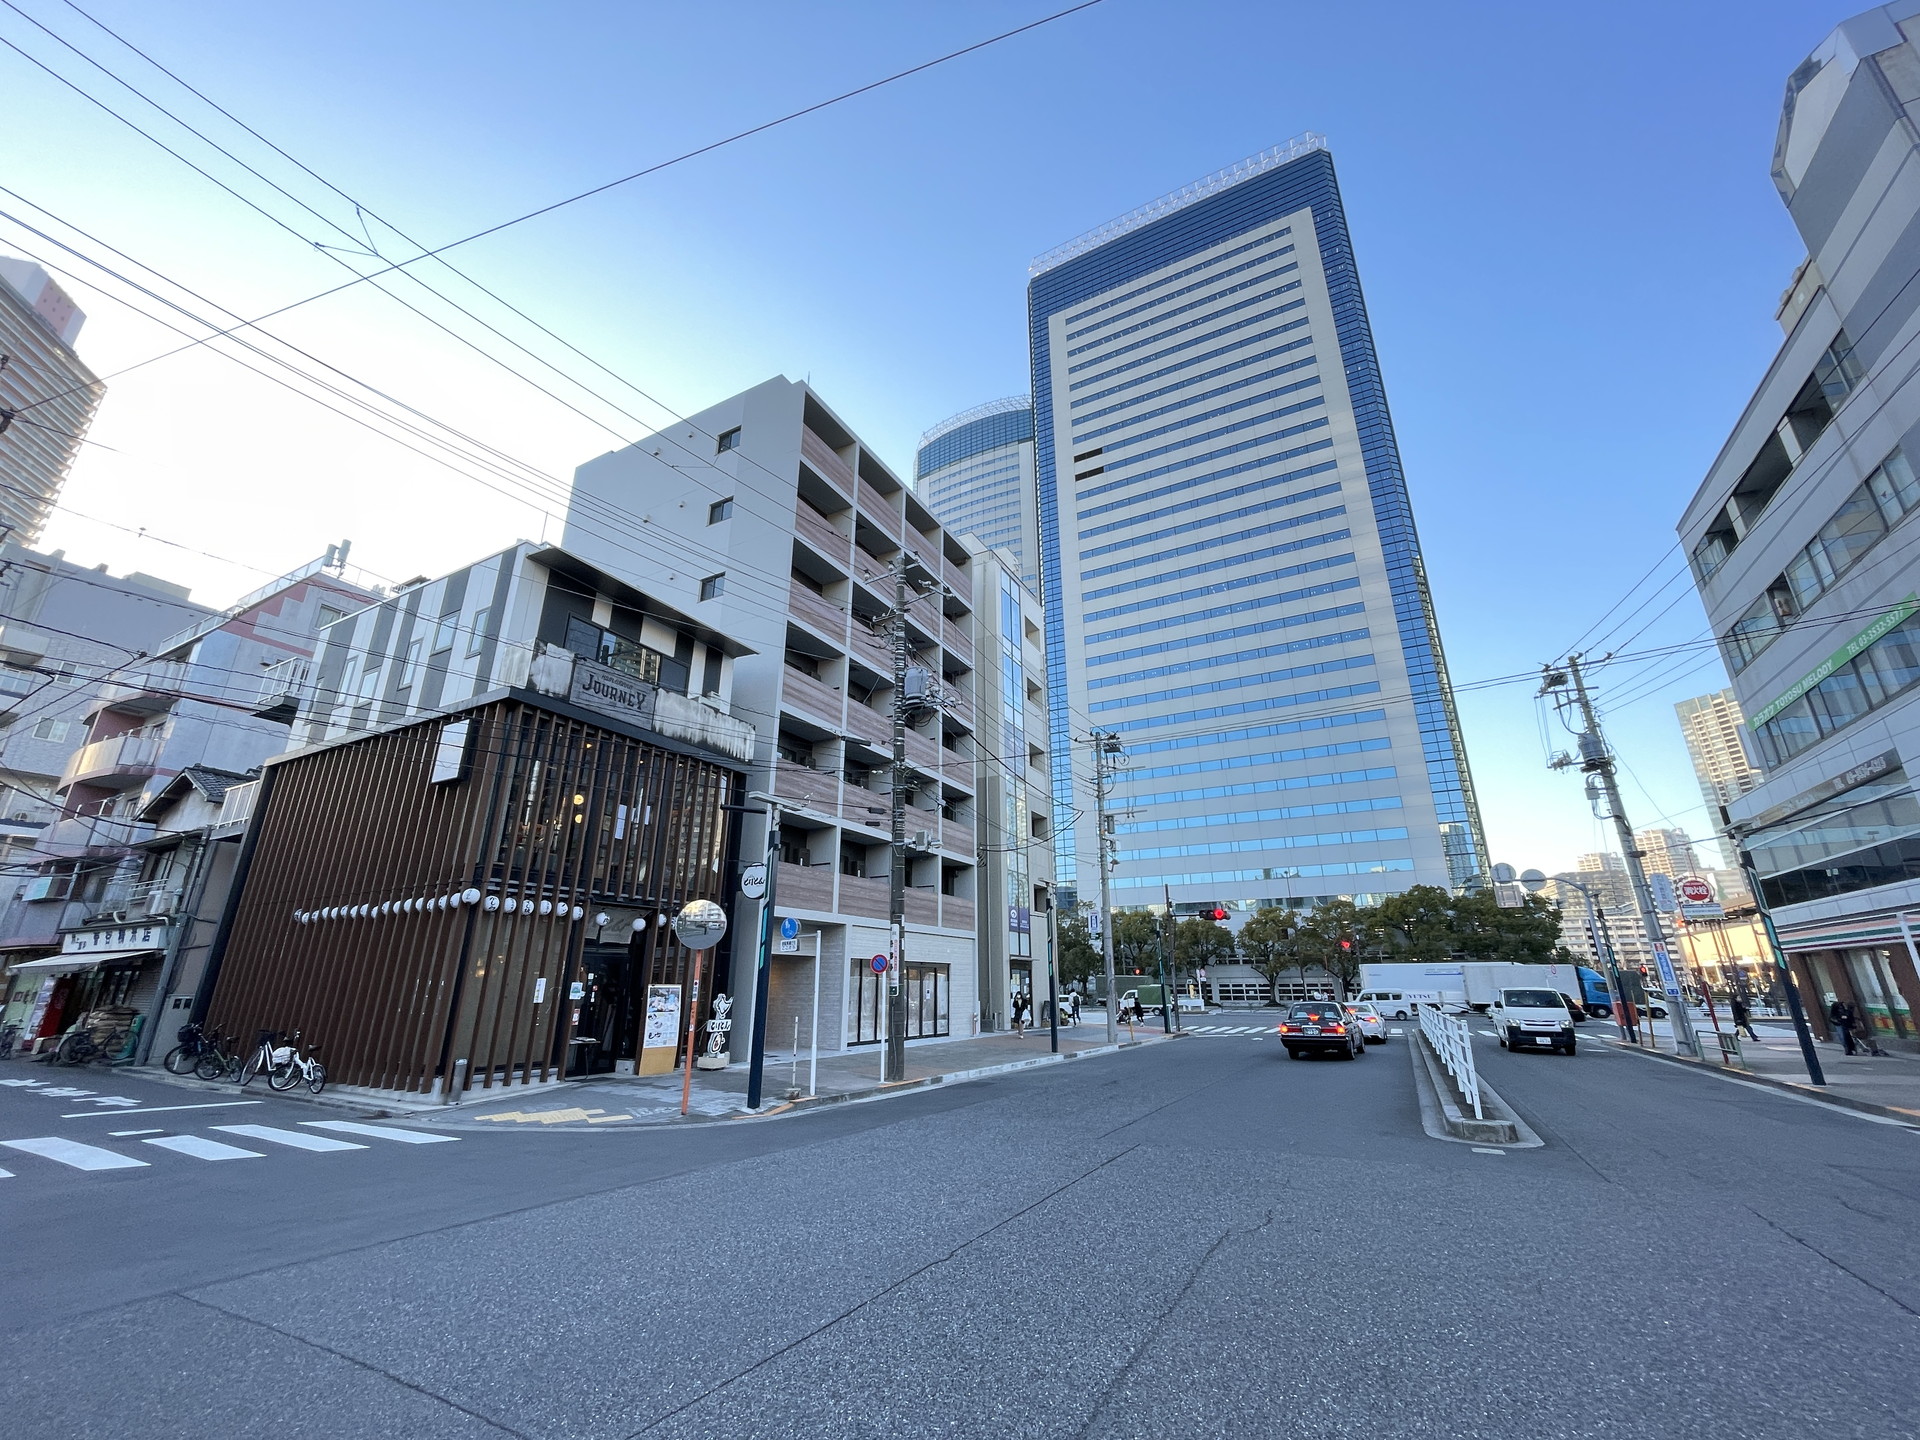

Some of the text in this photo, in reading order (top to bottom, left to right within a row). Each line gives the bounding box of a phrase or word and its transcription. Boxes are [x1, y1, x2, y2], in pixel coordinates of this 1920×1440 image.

[1753, 704, 1774, 727] カラオケ
[1775, 683, 1802, 709] TOYOSU
[1802, 660, 1832, 690] MELODY
[1846, 641, 1859, 655] TEL
[1683, 885, 1708, 895] 消火栓
